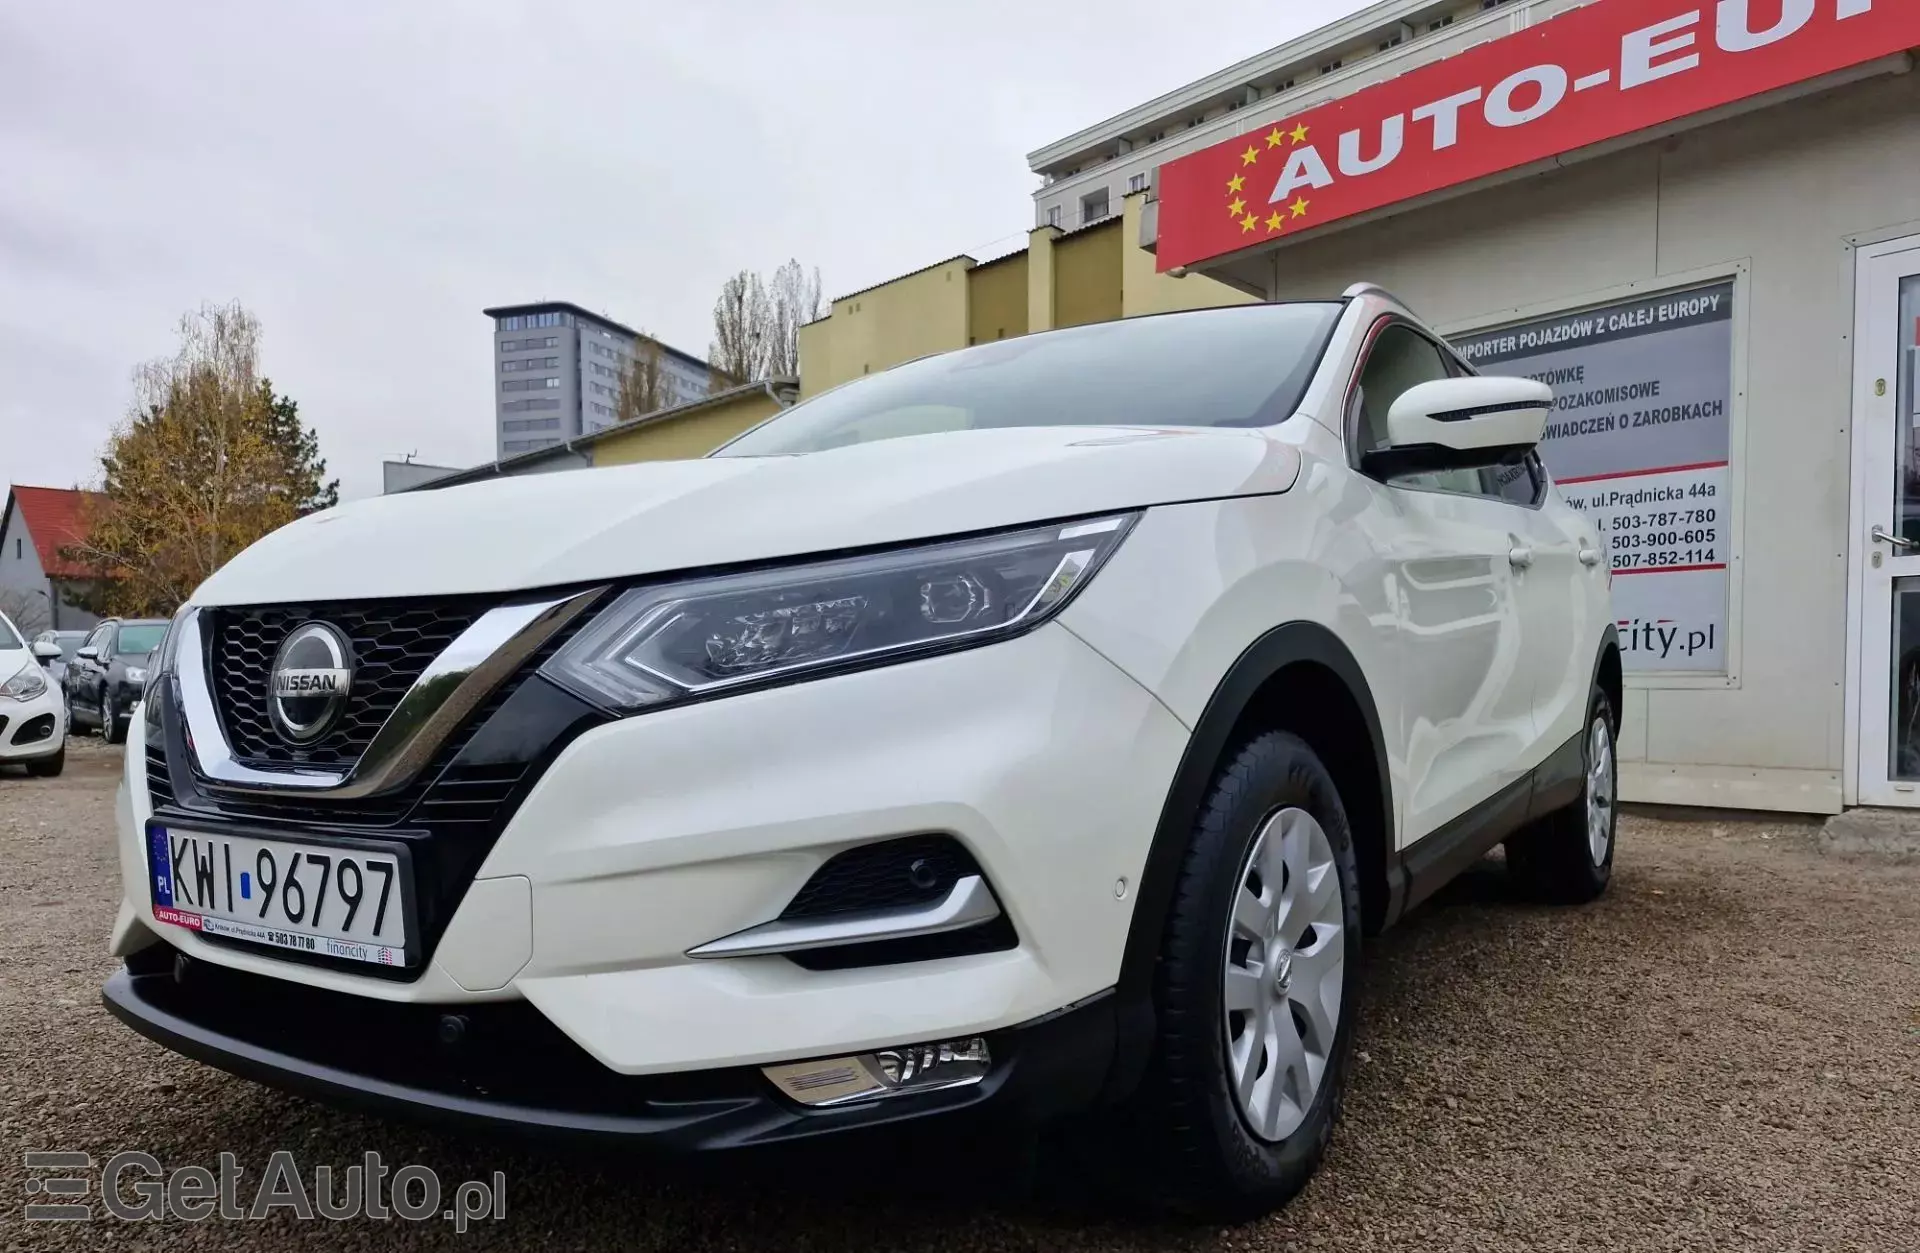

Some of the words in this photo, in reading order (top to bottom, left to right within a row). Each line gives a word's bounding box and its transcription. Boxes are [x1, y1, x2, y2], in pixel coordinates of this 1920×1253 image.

[1454, 336, 1516, 360] MPORTER
[1519, 319, 1592, 350] POJAZDÓW
[1596, 317, 1605, 334] Z
[1609, 307, 1654, 331] CAŁEJ
[1658, 294, 1721, 322] EUROPY
[1619, 412, 1628, 430] O
[1633, 399, 1723, 427] ZAROBKACH
[1592, 486, 1684, 508] ul.Prądnicka
[1688, 482, 1716, 499] 44a
[1612, 508, 1716, 531] 503-787-780
[1612, 528, 1716, 549] 503-900-605
[1612, 548, 1715, 568] 507-852-114
[276, 674, 337, 691] NISSAN
[157, 875, 171, 895] PL
[256, 847, 394, 937] 96797
[158, 910, 201, 927] AUTO-EURO
[326, 937, 368, 961] financity
